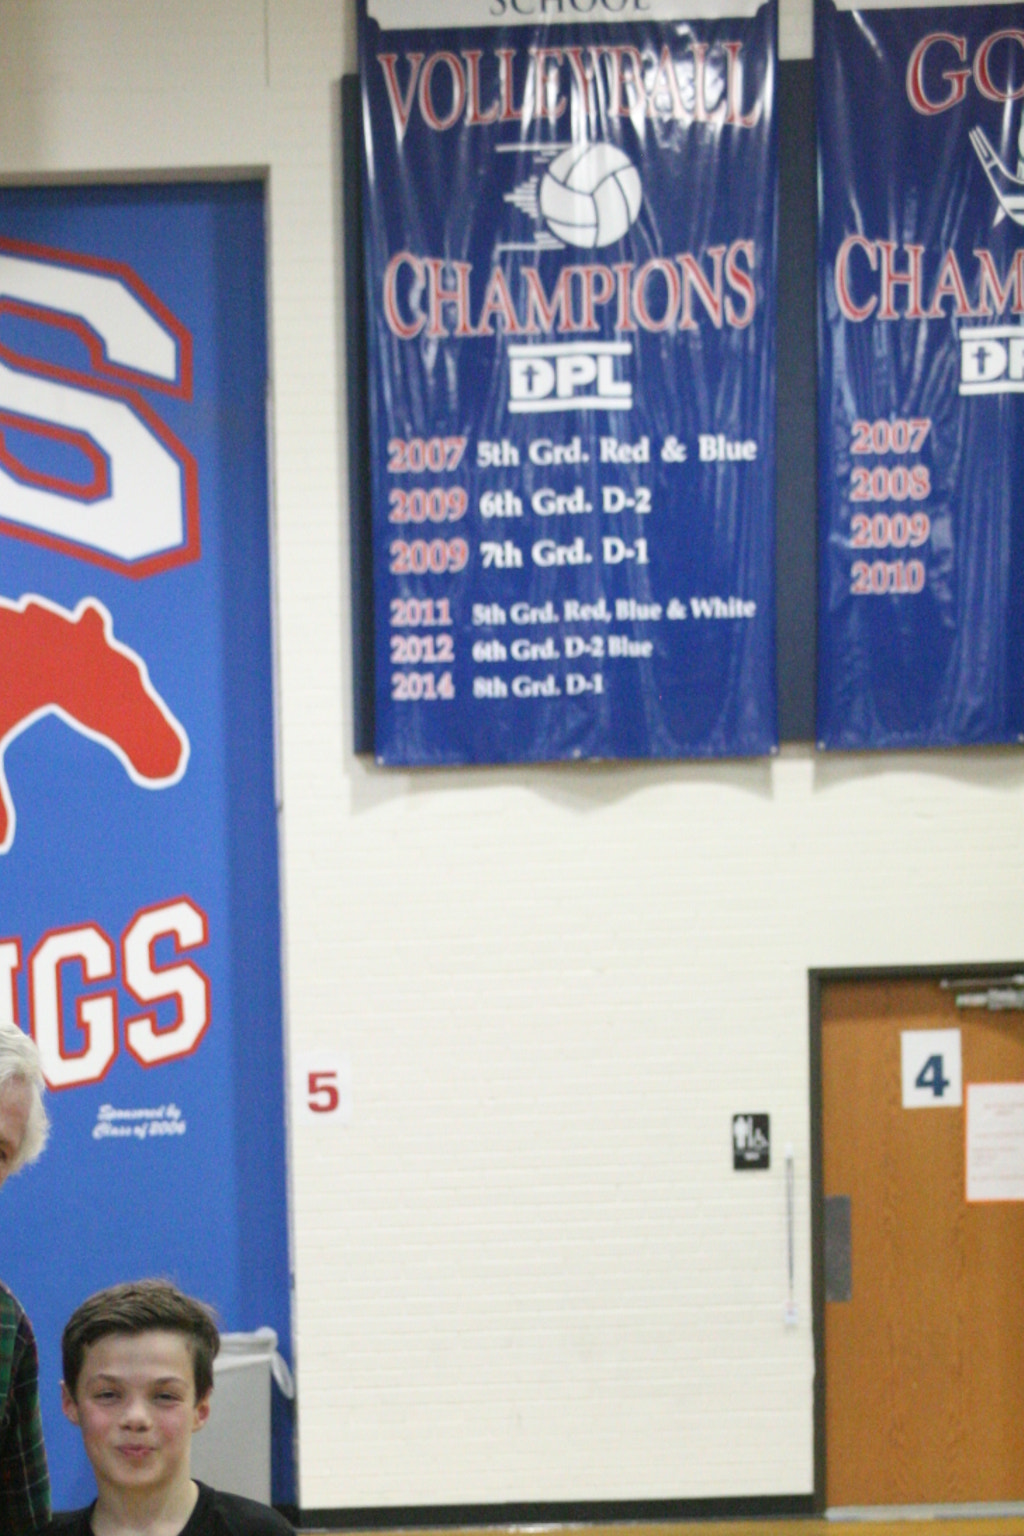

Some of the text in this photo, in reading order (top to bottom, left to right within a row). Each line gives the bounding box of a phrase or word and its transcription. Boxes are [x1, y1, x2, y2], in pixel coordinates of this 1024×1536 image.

[377, 41, 760, 136] VOLLEYBALL
[383, 240, 756, 340] CHAMPIONS
[509, 355, 632, 399] DPL
[386, 434, 758, 474] 2007 5th Grd. Red & Blue
[850, 418, 932, 455] 2007
[849, 466, 931, 502] 2008
[388, 486, 652, 524] 2009 6th Grd. D-2
[850, 513, 931, 549] 2009
[389, 537, 650, 575] 2009 7th Grd. D-1
[849, 560, 926, 595] 2010
[389, 598, 453, 627] 2011
[510, 601, 560, 625] Grd.
[564, 599, 612, 623] Red,
[615, 598, 662, 621] Blue
[666, 599, 688, 620] &
[690, 596, 757, 619] White
[390, 634, 455, 664] 2012
[510, 637, 560, 661] Grd.
[565, 636, 604, 659] D-2
[608, 635, 653, 658] Blue
[391, 671, 456, 701] 2014
[511, 674, 561, 698] Grd.
[566, 673, 604, 695] D-1
[307, 1070, 340, 1114] 5
[915, 1054, 950, 1098] 4
